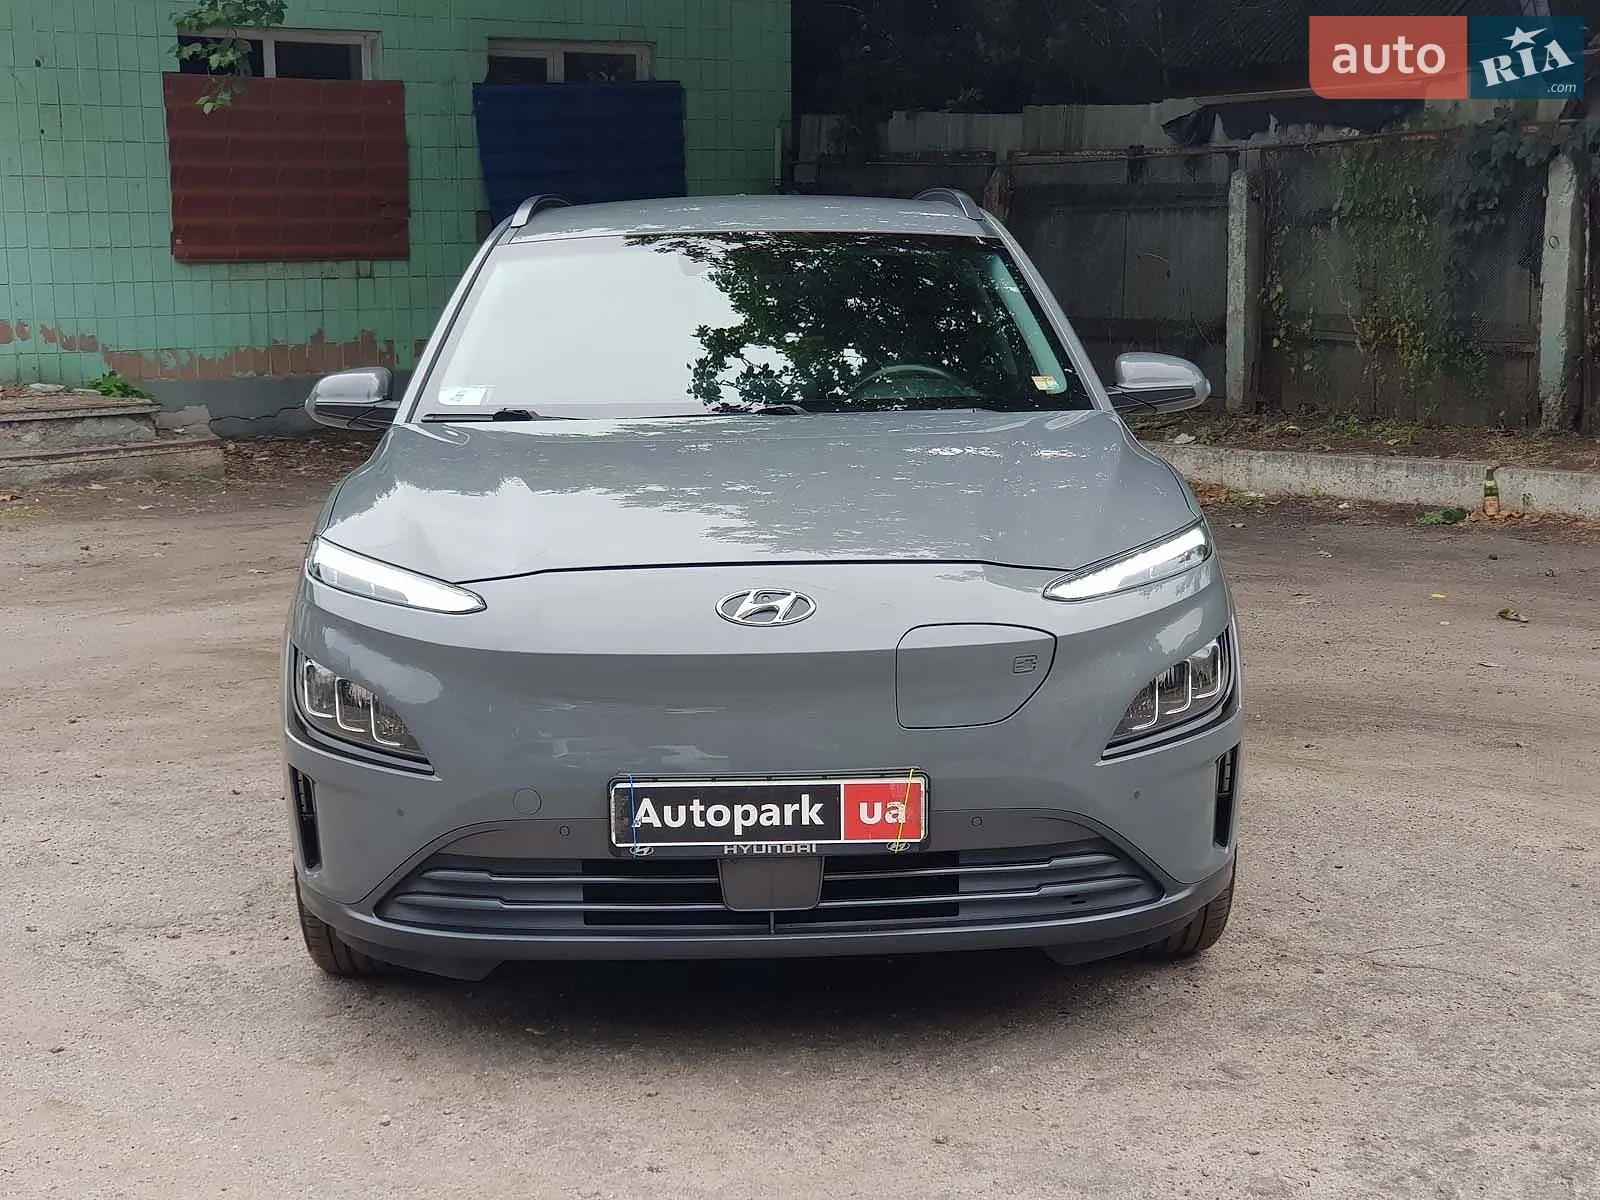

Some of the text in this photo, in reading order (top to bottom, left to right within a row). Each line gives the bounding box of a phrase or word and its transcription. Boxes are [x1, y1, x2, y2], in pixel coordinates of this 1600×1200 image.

[632, 794, 907, 835] Autopark ua
[723, 843, 817, 854] HYUNDAI
